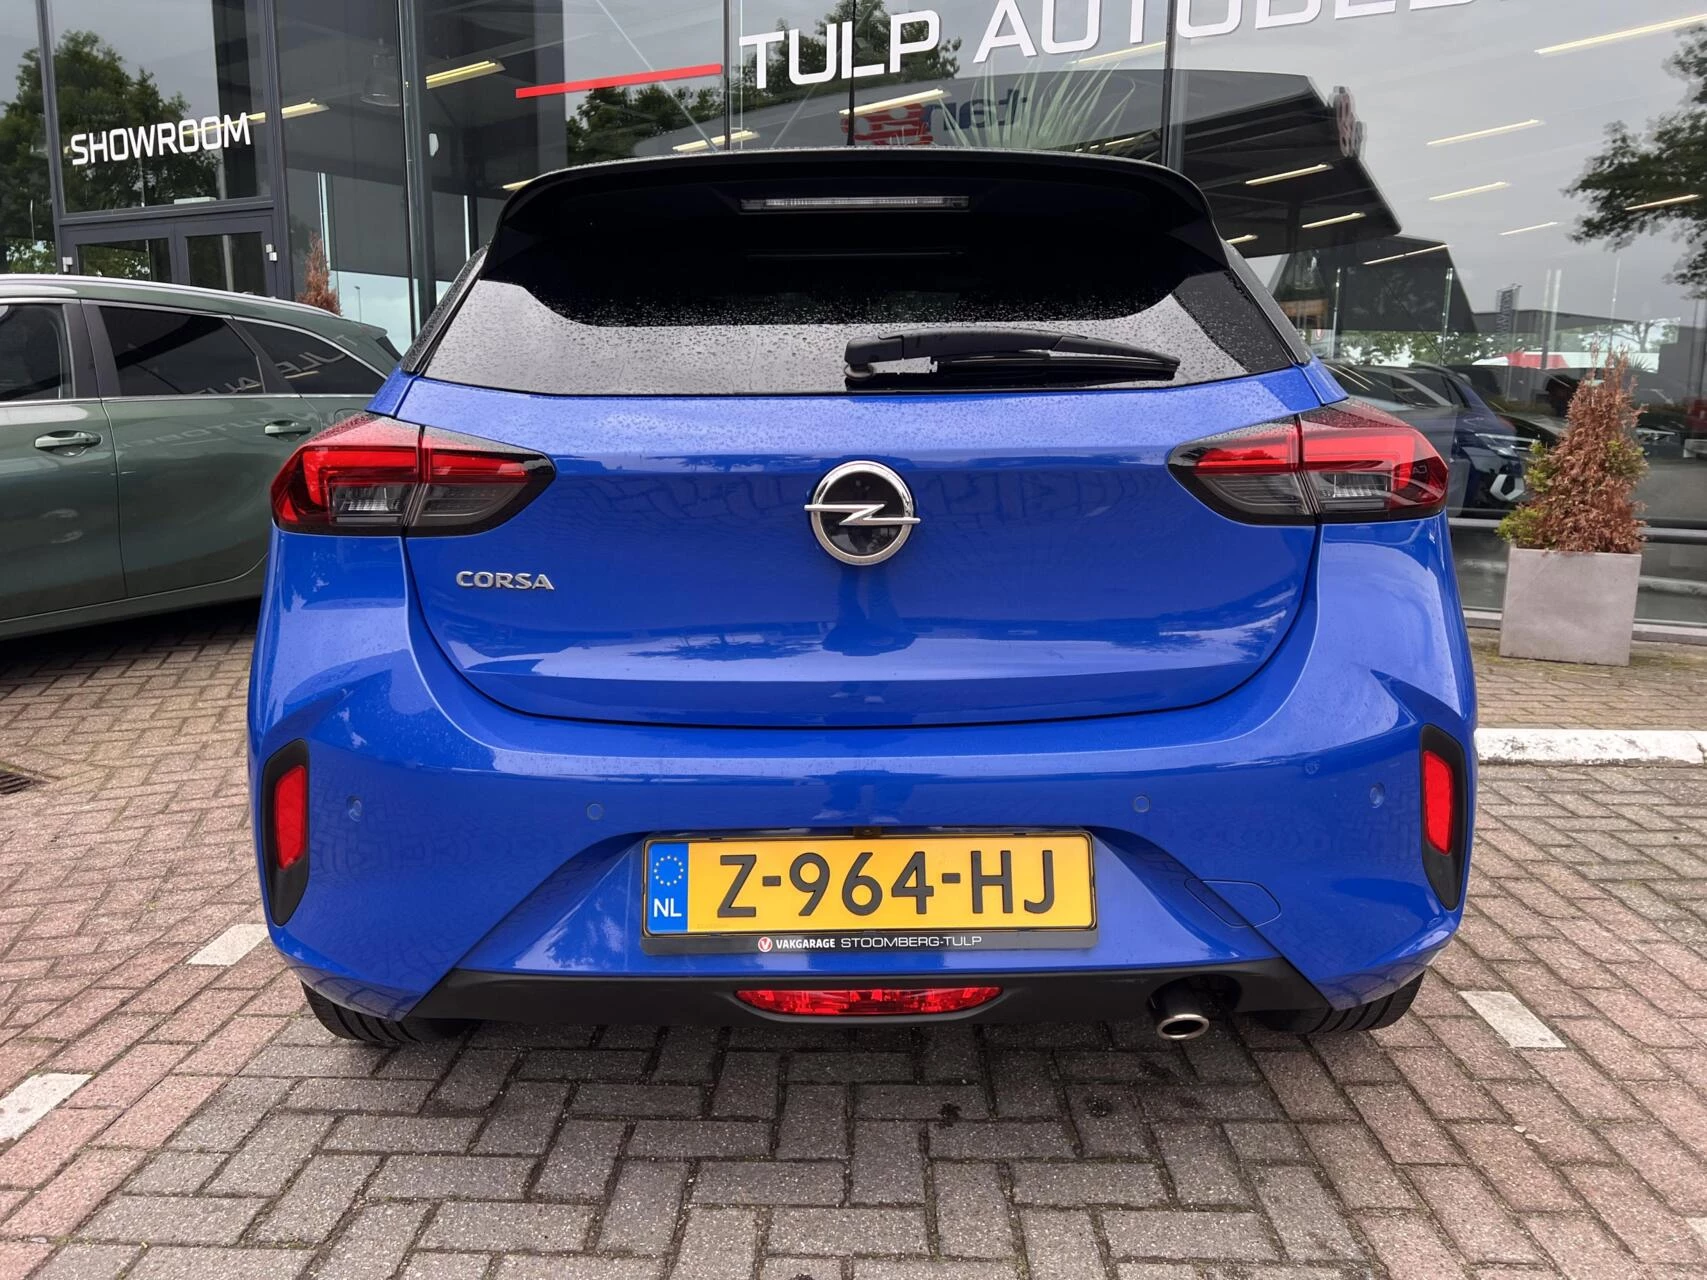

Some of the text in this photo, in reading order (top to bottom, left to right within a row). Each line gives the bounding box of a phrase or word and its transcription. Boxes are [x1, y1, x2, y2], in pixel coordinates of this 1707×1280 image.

[738, 10, 940, 89] TULP
[71, 112, 251, 165] SHOWROOM
[456, 571, 555, 590] CORSA
[717, 849, 1055, 918] Z-964-HJ
[653, 898, 682, 918] NL
[776, 938, 836, 949] VAKGARAGE
[841, 936, 982, 948] STOOMBERG-TULP
